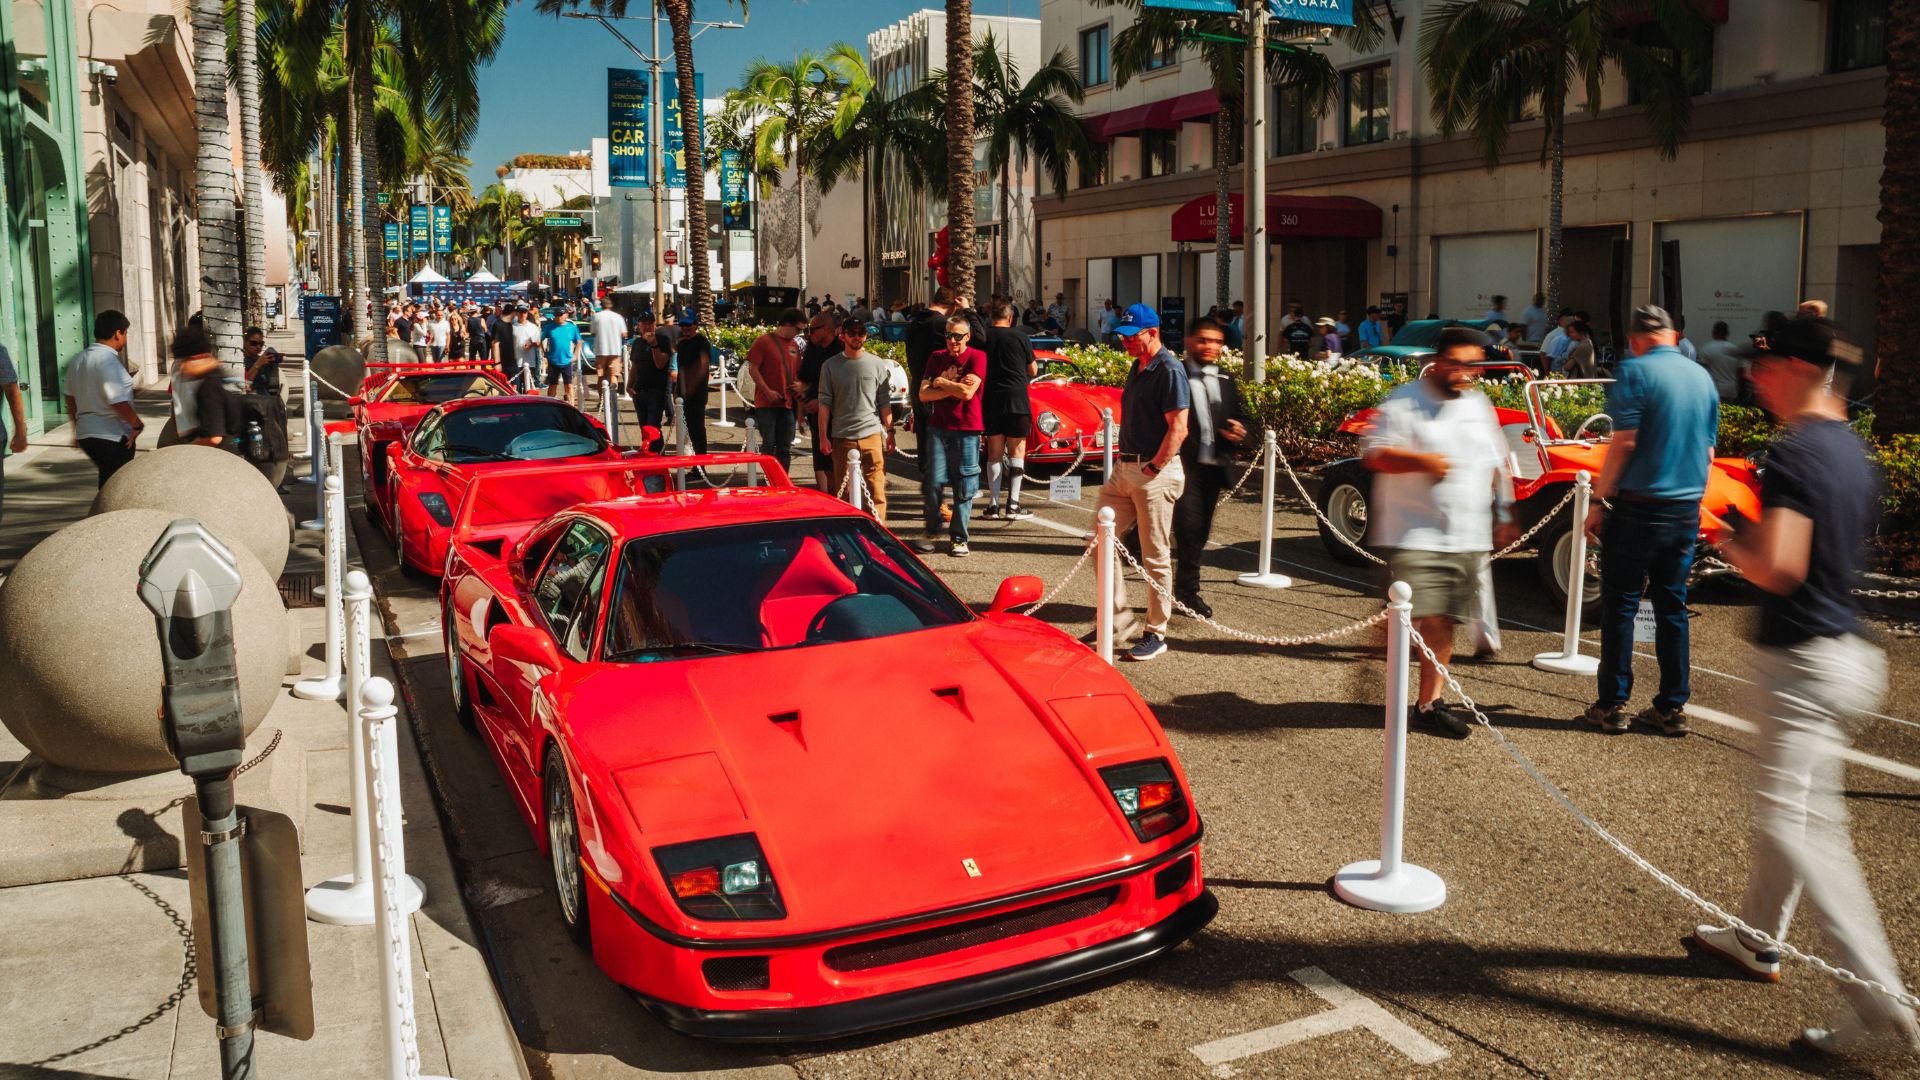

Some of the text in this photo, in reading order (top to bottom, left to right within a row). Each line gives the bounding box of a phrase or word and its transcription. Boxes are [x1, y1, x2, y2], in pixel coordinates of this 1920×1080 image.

[667, 99, 700, 110] JUE
[612, 129, 645, 144] CAR
[612, 146, 645, 156] SHOW
[1200, 203, 1234, 217] LUE
[1281, 215, 1298, 225] 360
[890, 250, 907, 260] BURCH
[841, 253, 862, 269] Cartier
